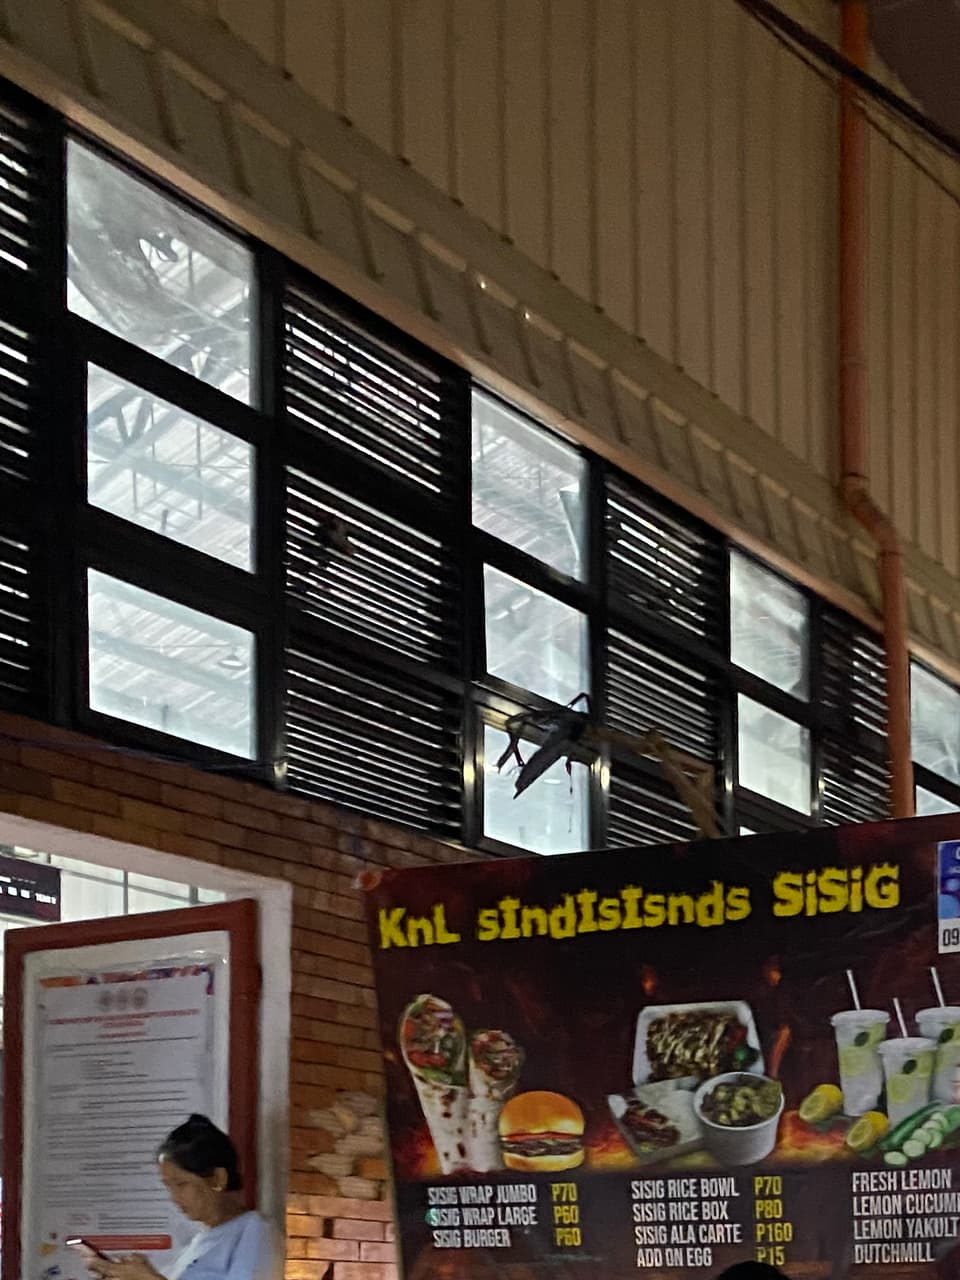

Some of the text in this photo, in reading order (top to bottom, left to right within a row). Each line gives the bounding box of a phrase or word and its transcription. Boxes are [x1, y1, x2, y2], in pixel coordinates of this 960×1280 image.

[631, 1176, 781, 1199] SISIG RICE BOWL P70
[853, 1171, 897, 1192] FRESH
[902, 1169, 952, 1190] LEMON
[428, 1183, 577, 1204] SISIG WRAP JUMBO P70
[430, 1208, 459, 1226] SISIG
[463, 1207, 494, 1225] WRAP
[498, 1206, 538, 1225] LARGE
[633, 1200, 783, 1222] SISIG RICE BOX P80
[853, 1195, 901, 1216] LEMON
[433, 1230, 461, 1247] SISIG
[464, 1229, 511, 1247] BURGER
[635, 1223, 792, 1244] SISIG ALA CARTE P160
[854, 1219, 902, 1239] LEMON
[906, 1217, 960, 1238] YAKULT
[637, 1247, 784, 1267] ADD ON EGG P15
[855, 1242, 935, 1263] DUTCHMILL
